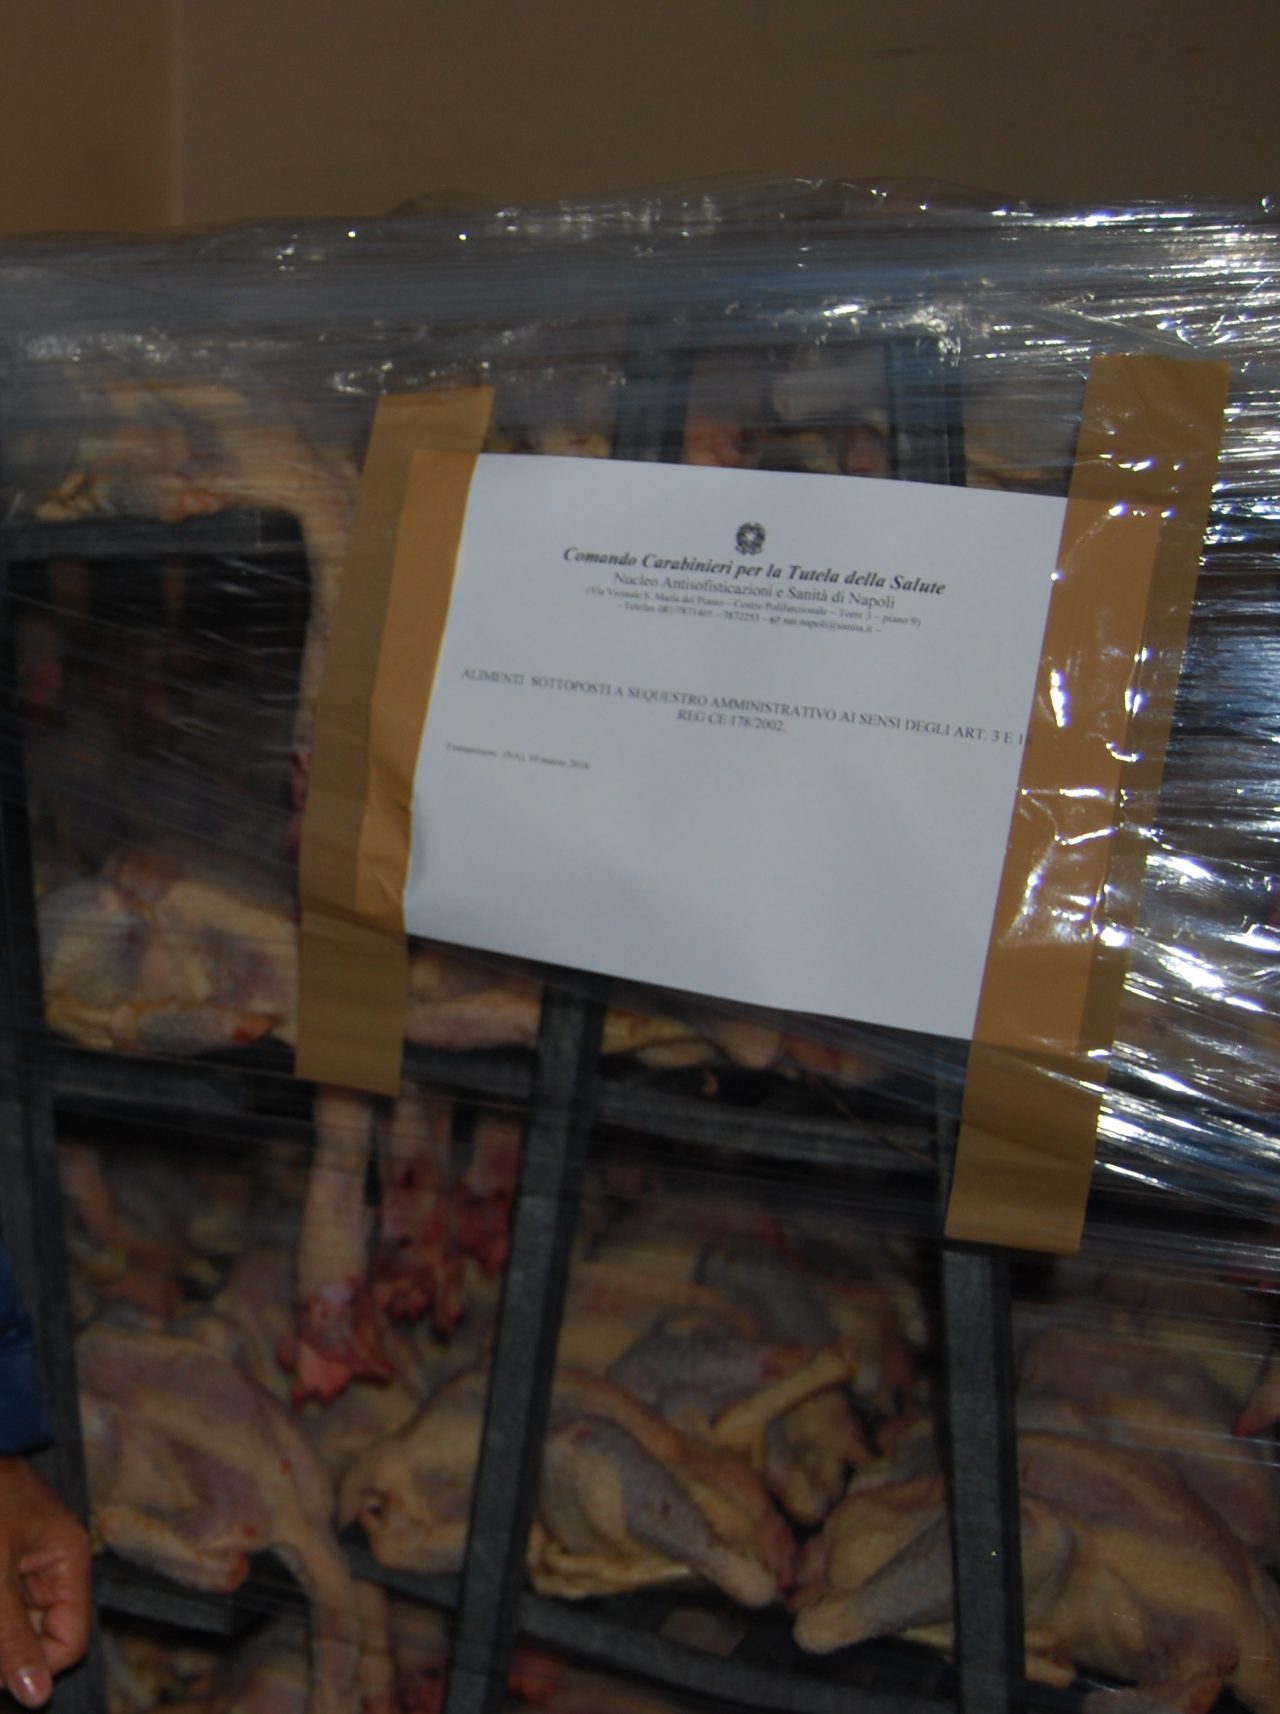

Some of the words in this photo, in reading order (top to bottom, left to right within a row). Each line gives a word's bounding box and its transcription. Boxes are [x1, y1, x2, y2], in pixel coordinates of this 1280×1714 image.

[563, 547, 637, 567] Comando
[642, 553, 734, 575] Carabinieri
[734, 564, 763, 579] per
[766, 563, 782, 578] la
[788, 565, 840, 584] Tutela
[844, 570, 885, 588] della
[890, 575, 946, 595] Salute
[614, 572, 658, 587] Nucleo
[663, 577, 772, 597] Antisofisticazioni
[776, 588, 784, 598] e
[788, 585, 828, 602] Sanità
[832, 590, 844, 604] di
[849, 592, 895, 610] Napoli
[882, 613, 908, 626] piano
[462, 668, 524, 686] ALIMENTI
[531, 676, 611, 696] SOTTOPOSTI
[614, 686, 624, 697] A
[627, 686, 708, 707] SEQUESTRO
[711, 697, 837, 721] AMMINISTRATIVO
[840, 711, 856, 723] AI
[859, 713, 901, 729] SENSI
[905, 718, 950, 736] DEGLI
[954, 726, 987, 742] ART.
[992, 730, 1000, 743] 3
[1004, 731, 1013, 744] E
[677, 708, 705, 723] REG
[708, 712, 727, 726] CE
